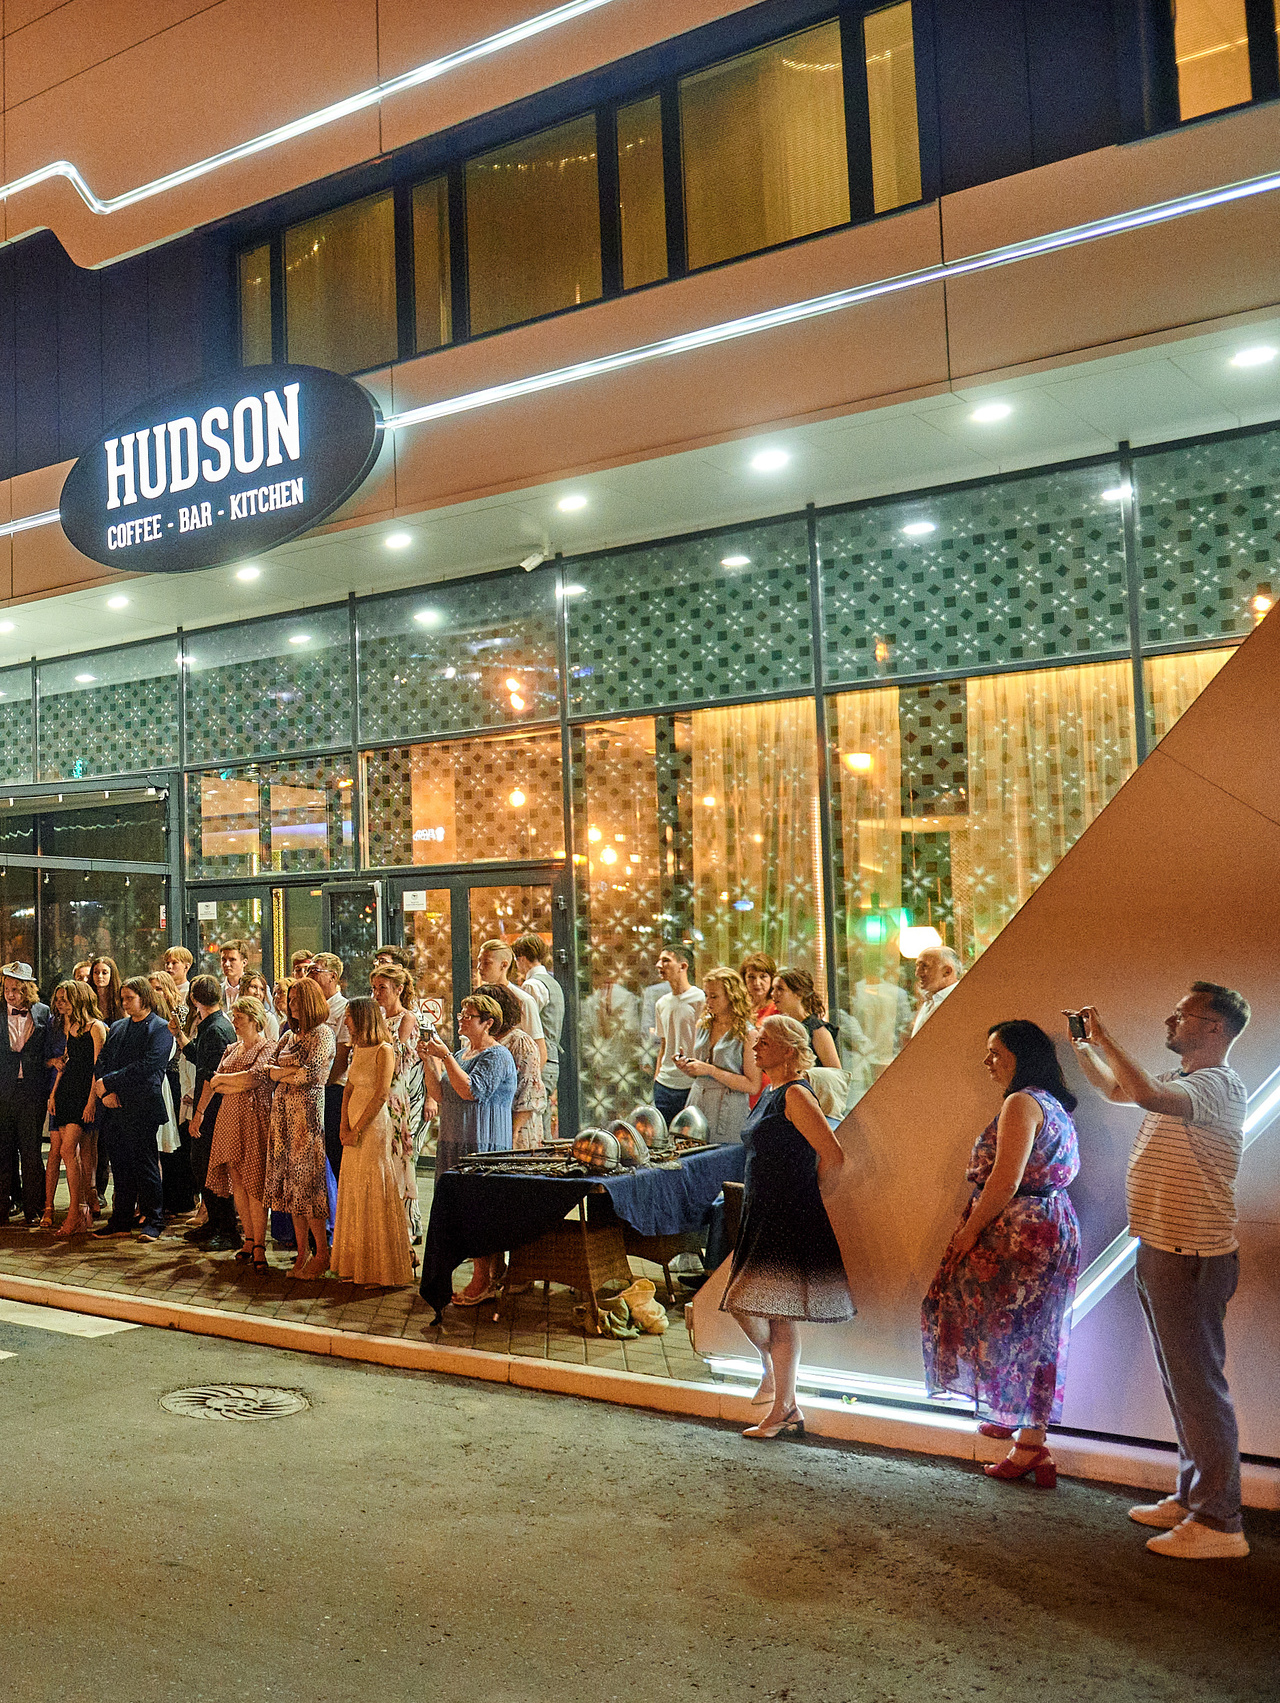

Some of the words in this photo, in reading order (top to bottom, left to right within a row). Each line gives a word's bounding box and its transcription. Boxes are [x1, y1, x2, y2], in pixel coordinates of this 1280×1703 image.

[104, 382, 300, 510] HUDSON
[107, 513, 163, 551] COFFEE
[178, 501, 213, 533] BAR
[229, 476, 304, 521] KITCHEN
